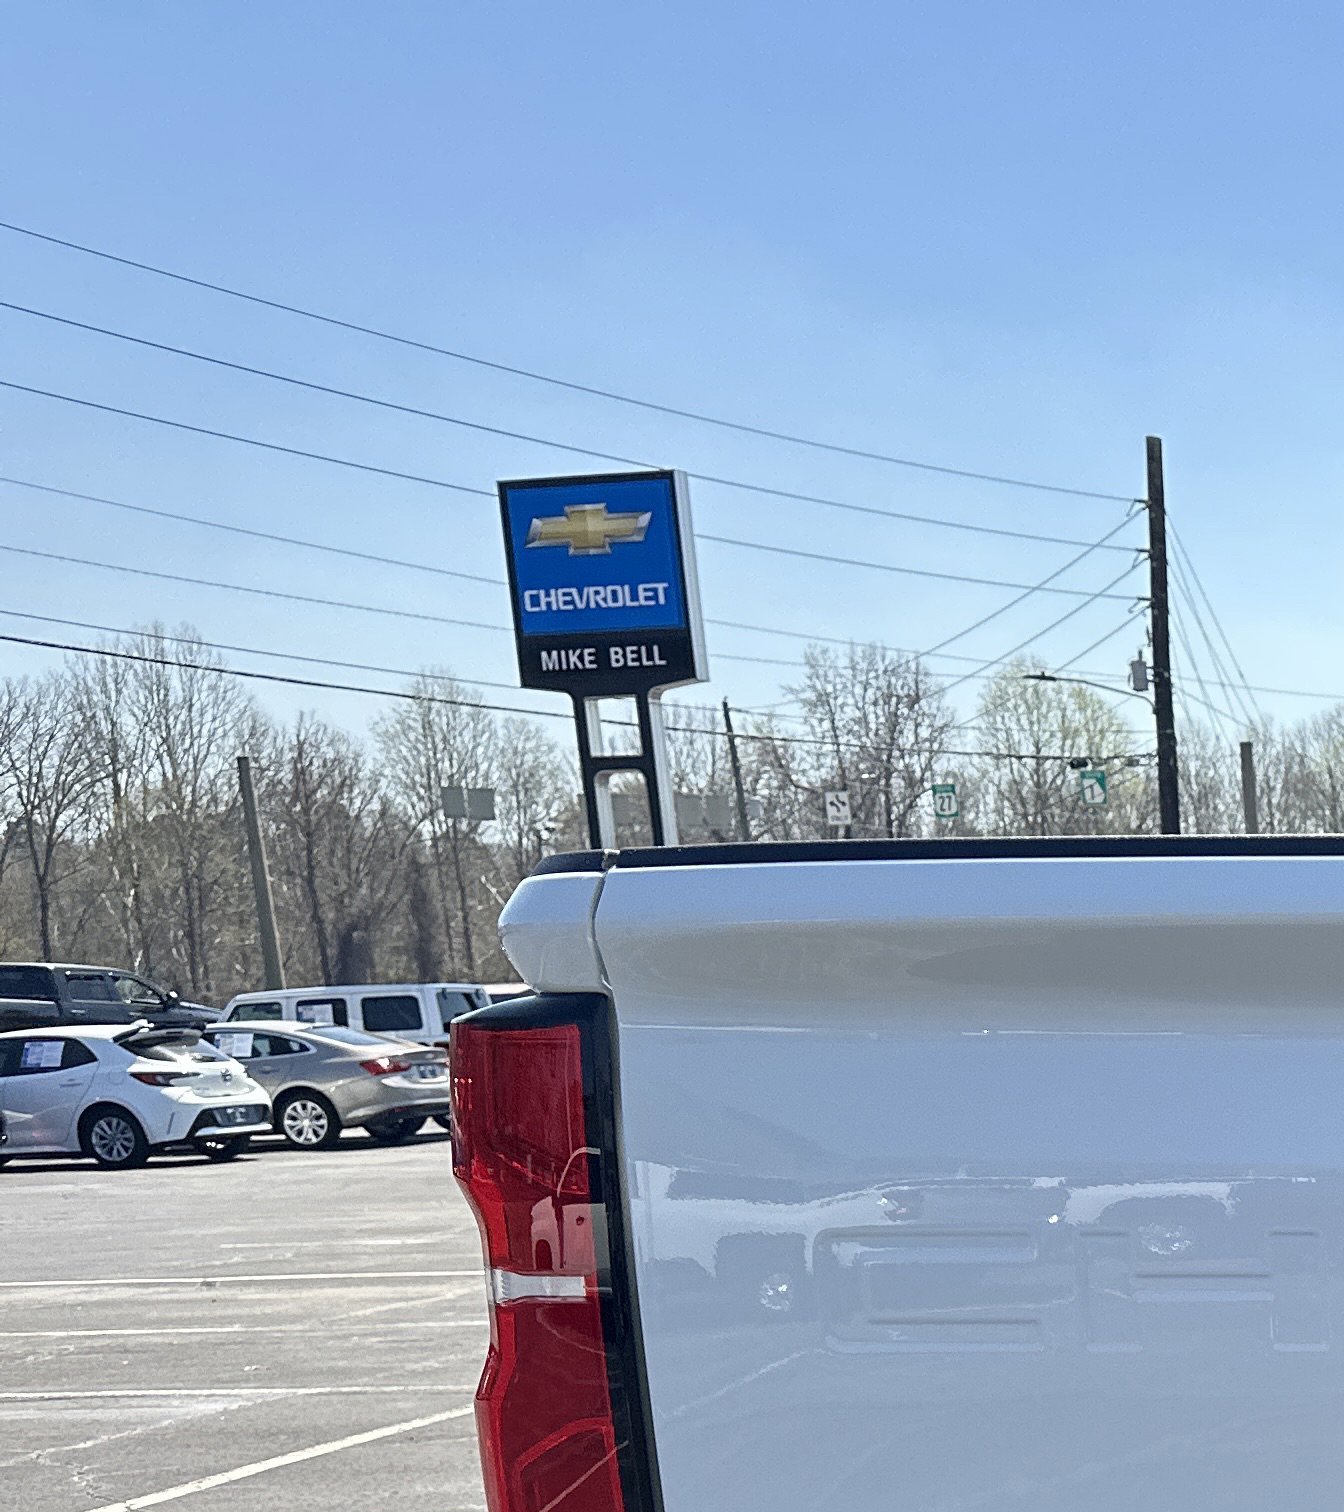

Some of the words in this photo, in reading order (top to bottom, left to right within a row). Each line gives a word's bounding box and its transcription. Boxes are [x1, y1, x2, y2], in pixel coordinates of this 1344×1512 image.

[523, 582, 669, 613] CHEVROLET
[540, 648, 598, 671] MIKE
[609, 644, 667, 668] BELL
[939, 795, 951, 812] 27
